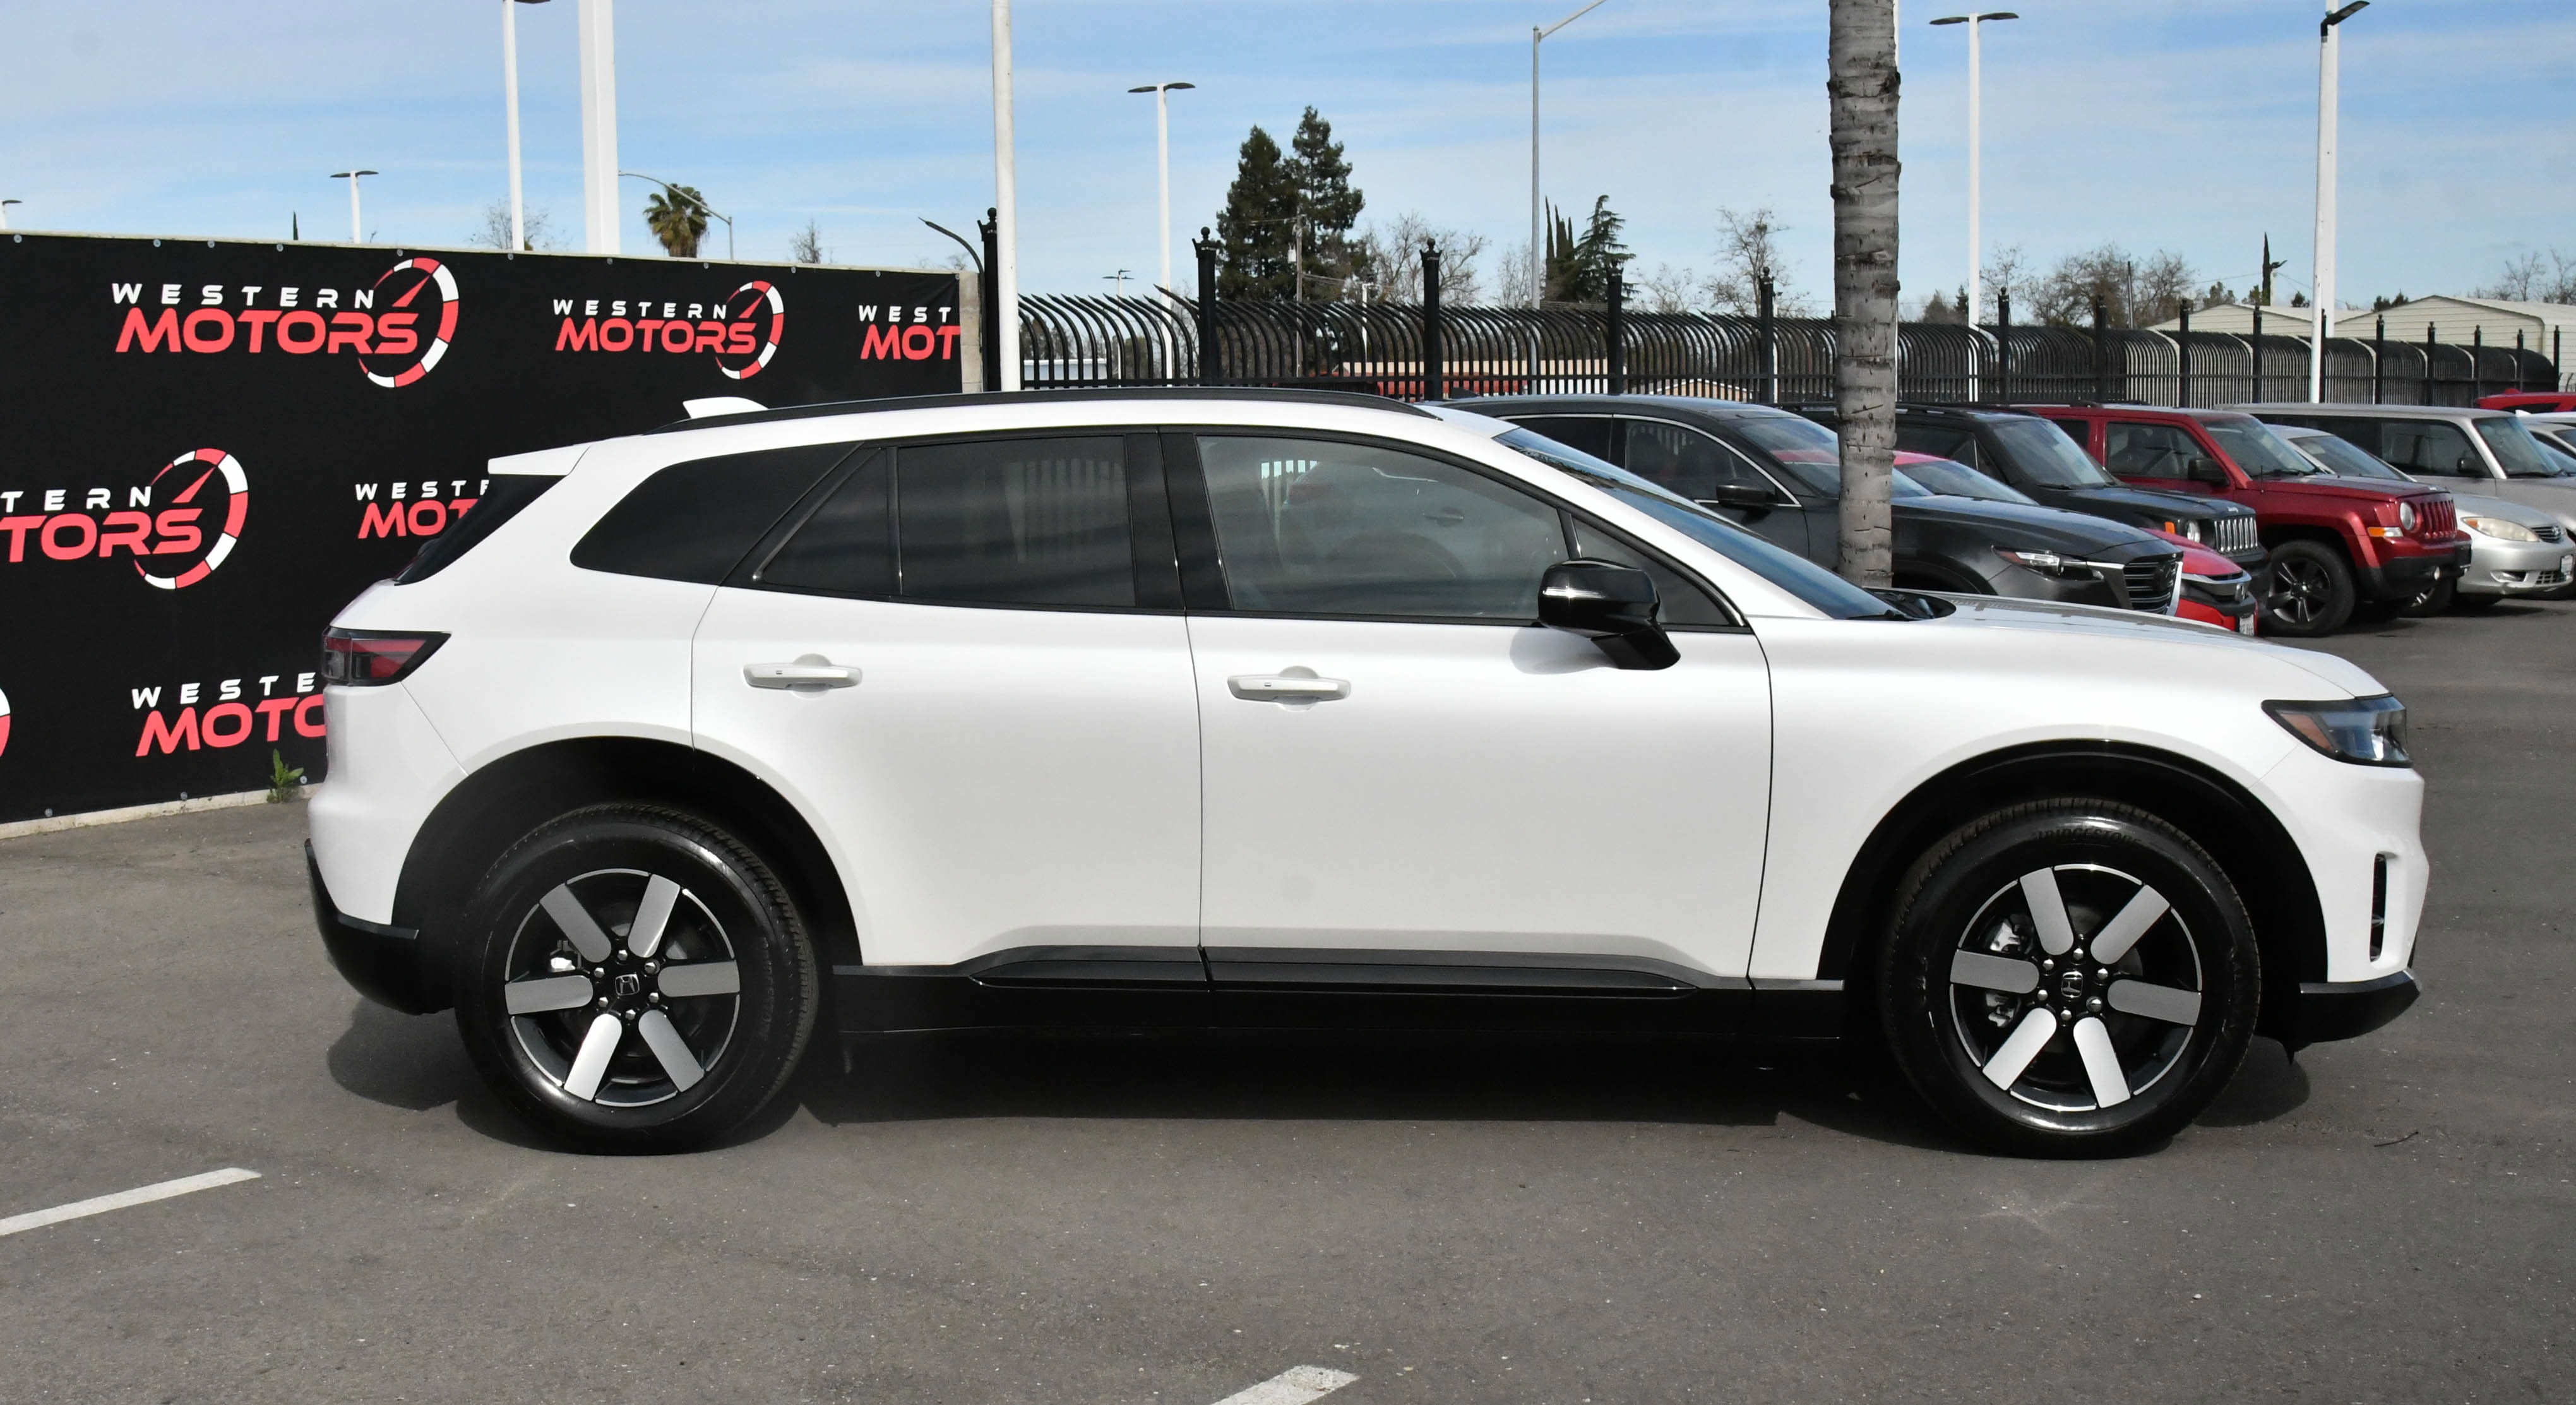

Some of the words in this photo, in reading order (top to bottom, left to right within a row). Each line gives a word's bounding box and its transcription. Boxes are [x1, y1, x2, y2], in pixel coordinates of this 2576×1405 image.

[112, 283, 374, 309] WESTERN
[553, 299, 727, 320] WESTERN
[858, 305, 951, 323] WEST
[116, 307, 419, 354] MOTORS
[556, 317, 756, 354] MOTORS
[861, 324, 961, 360] MOT
[0, 486, 152, 513] TERN
[0, 508, 203, 563] TORS
[131, 672, 316, 709] WESTE
